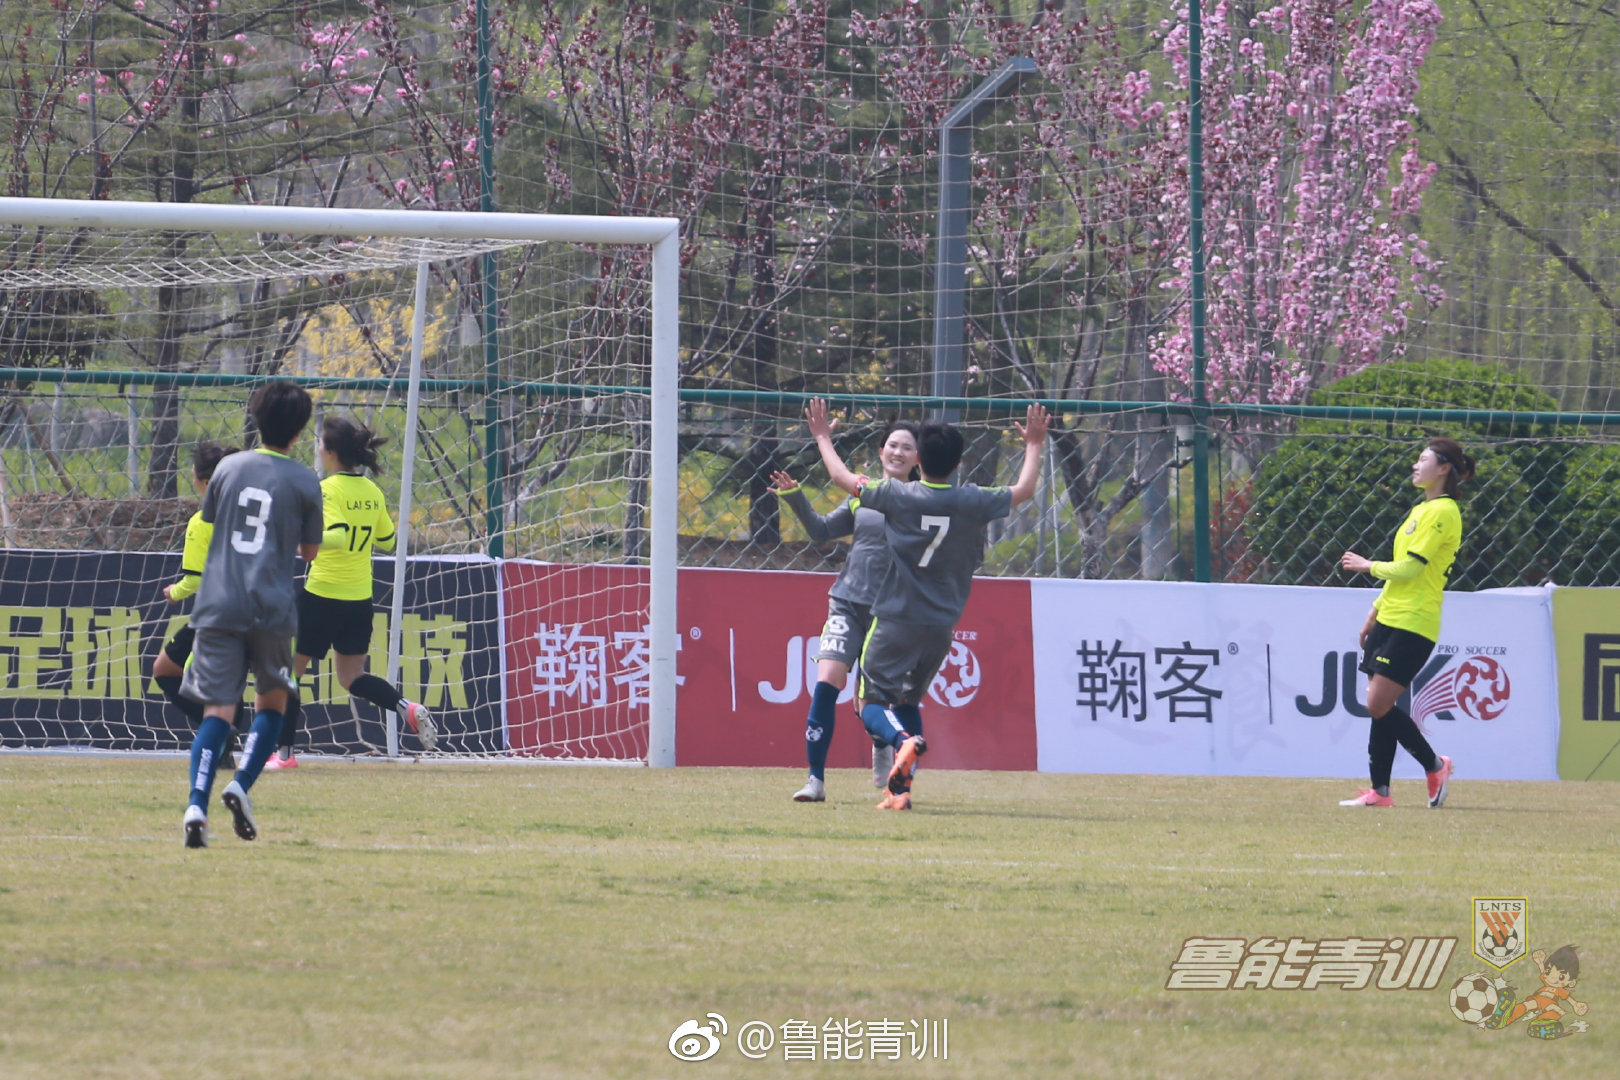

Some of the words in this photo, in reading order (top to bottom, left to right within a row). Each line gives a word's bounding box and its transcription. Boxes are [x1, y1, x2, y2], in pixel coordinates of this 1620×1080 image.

[230, 486, 273, 556] 3
[349, 525, 373, 552] 17
[917, 514, 951, 568] 7
[1437, 644, 1459, 655] PRO
[1465, 645, 1508, 656] SOCCER
[1076, 639, 1223, 723] 鞠客
